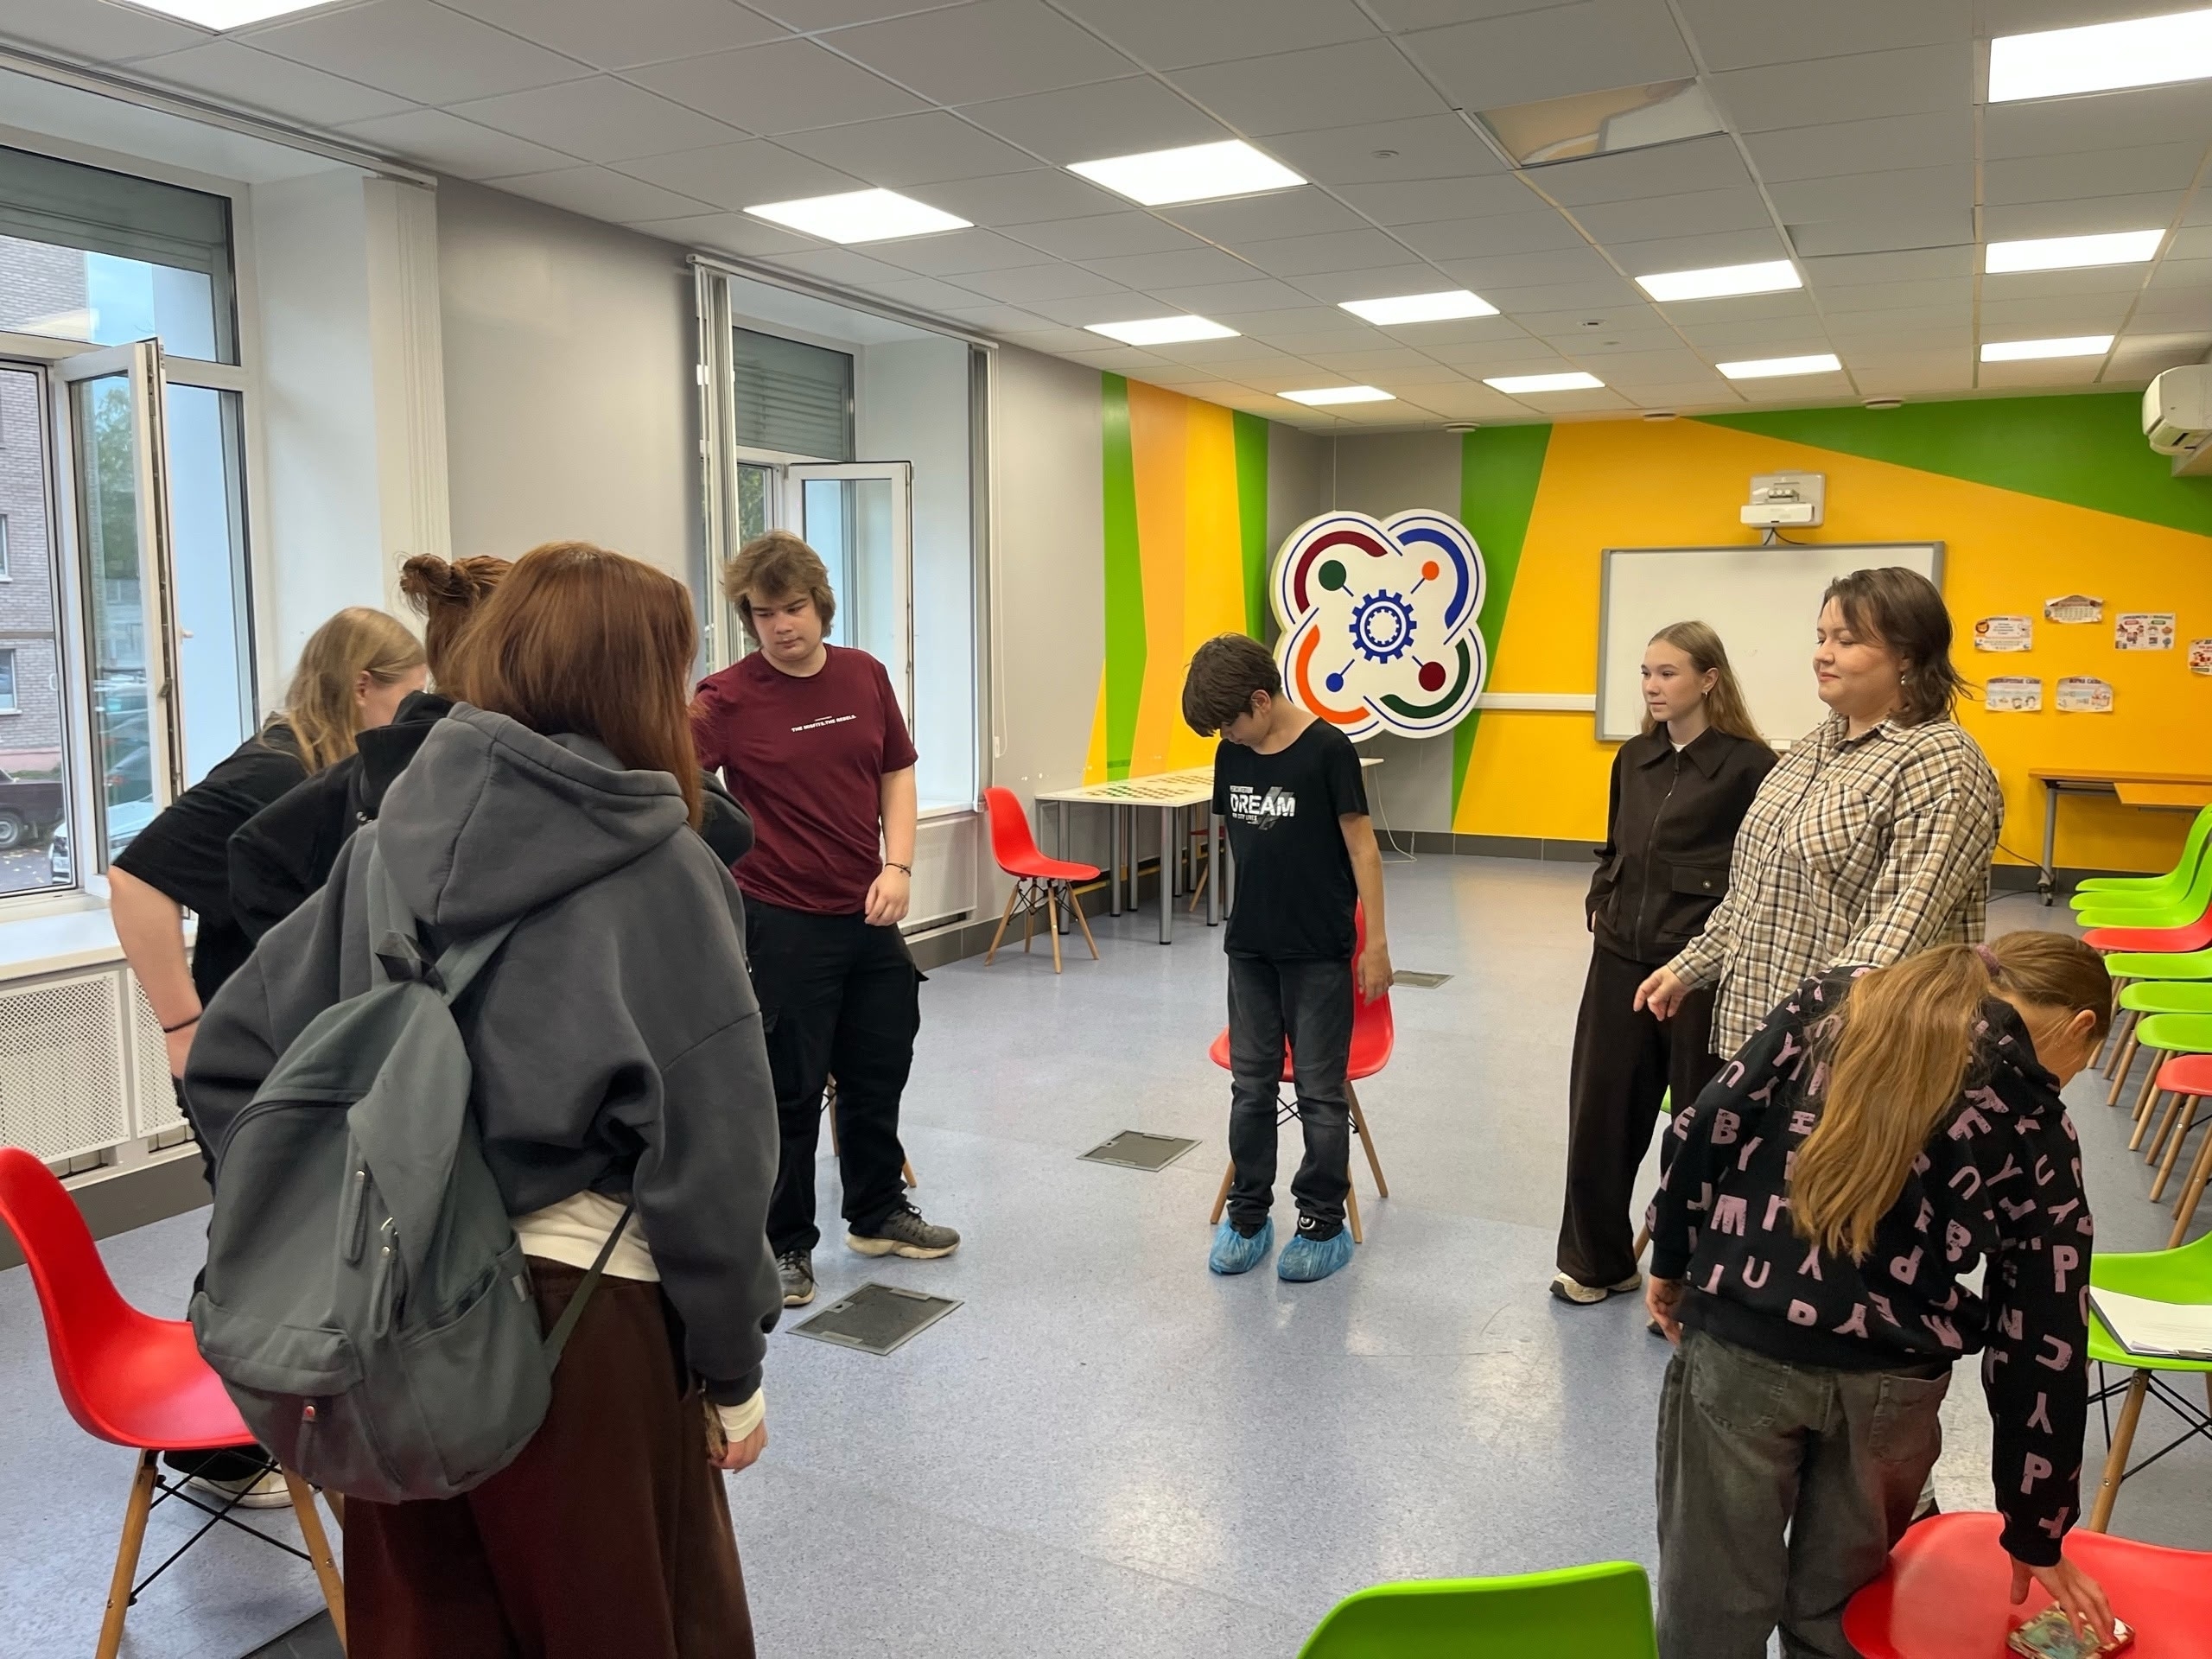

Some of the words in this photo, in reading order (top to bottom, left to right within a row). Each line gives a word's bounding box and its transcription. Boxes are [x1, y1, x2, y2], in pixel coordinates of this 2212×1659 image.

[1230, 793, 1295, 817] DREAM
[1710, 1107, 1741, 1145] B
[1986, 1152, 2024, 1187] Y
[1946, 1218, 1973, 1262] B
[1742, 1255, 1771, 1289] U
[2052, 1244, 2080, 1294] P
[2026, 1391, 2054, 1435] Y
[2019, 1451, 2054, 1495] P
